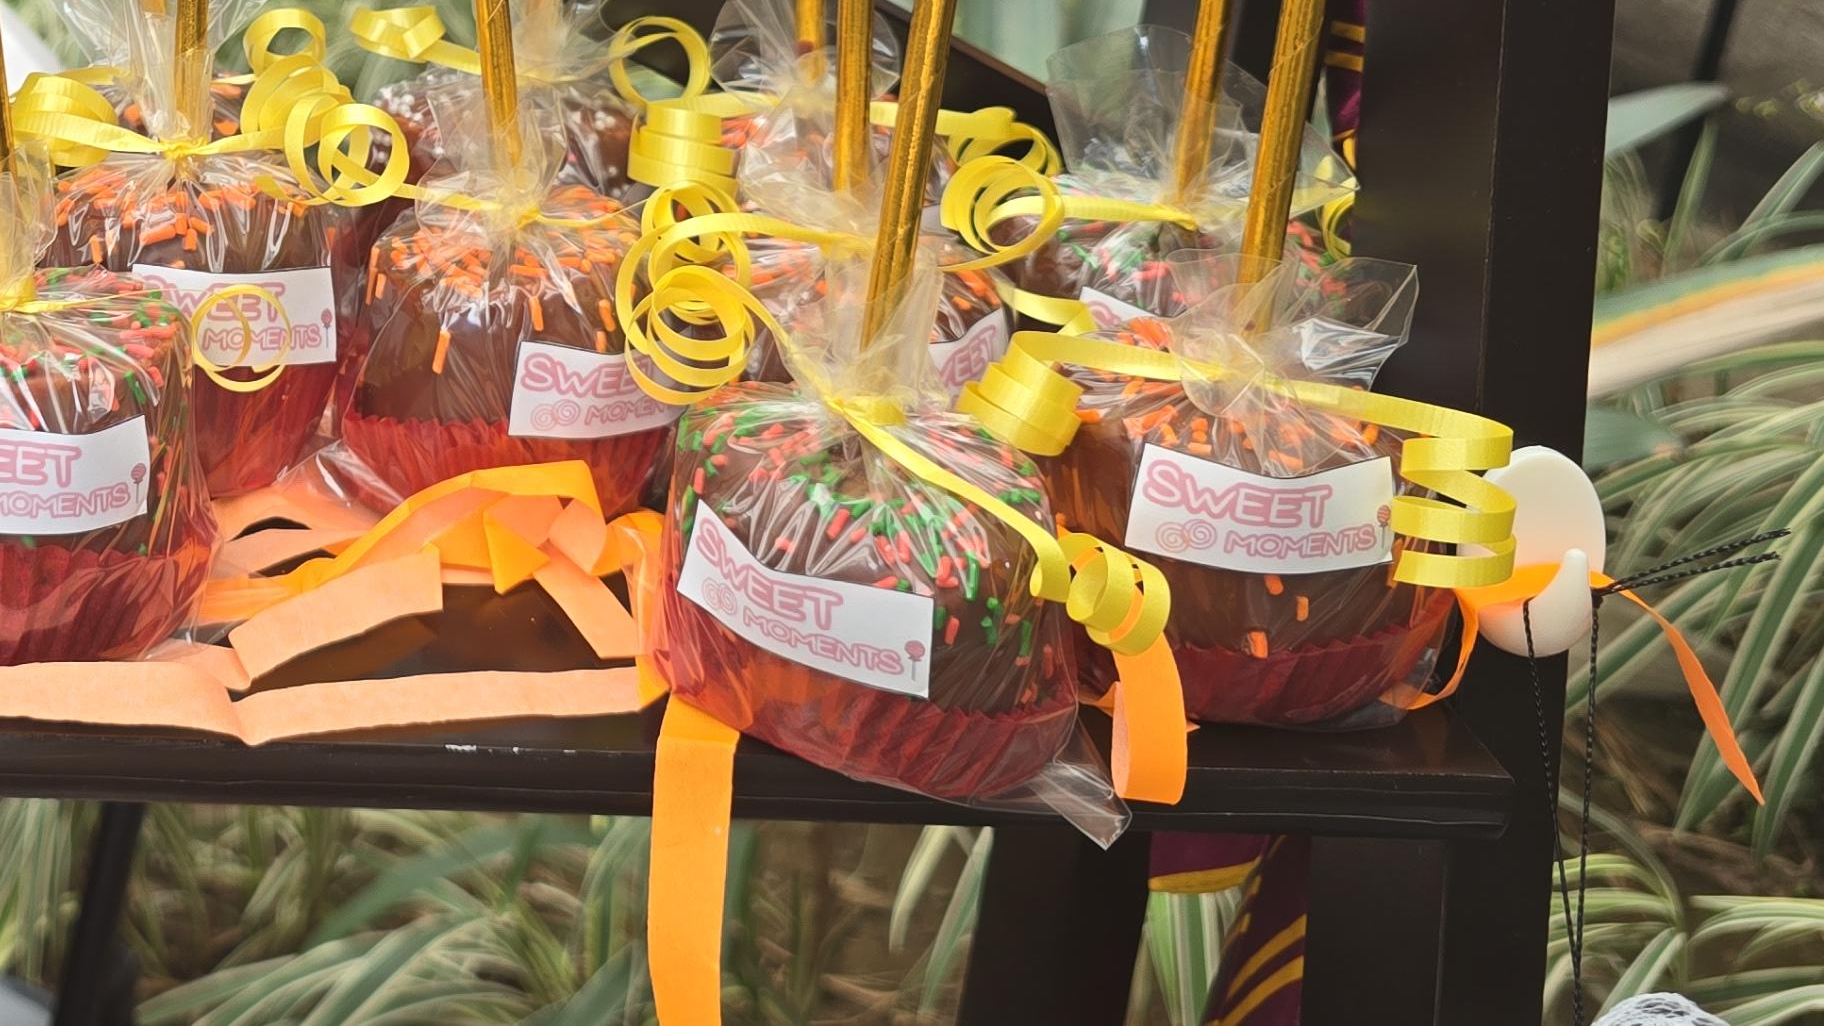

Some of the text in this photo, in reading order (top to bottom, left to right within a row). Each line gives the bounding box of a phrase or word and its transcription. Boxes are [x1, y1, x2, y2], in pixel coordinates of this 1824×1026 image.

[584, 395, 666, 426] MOMEN
[1142, 459, 1333, 528] SWEET
[695, 517, 843, 631] SWEET
[1223, 524, 1375, 559] MOMENTS
[742, 605, 904, 674] MOMENTS
